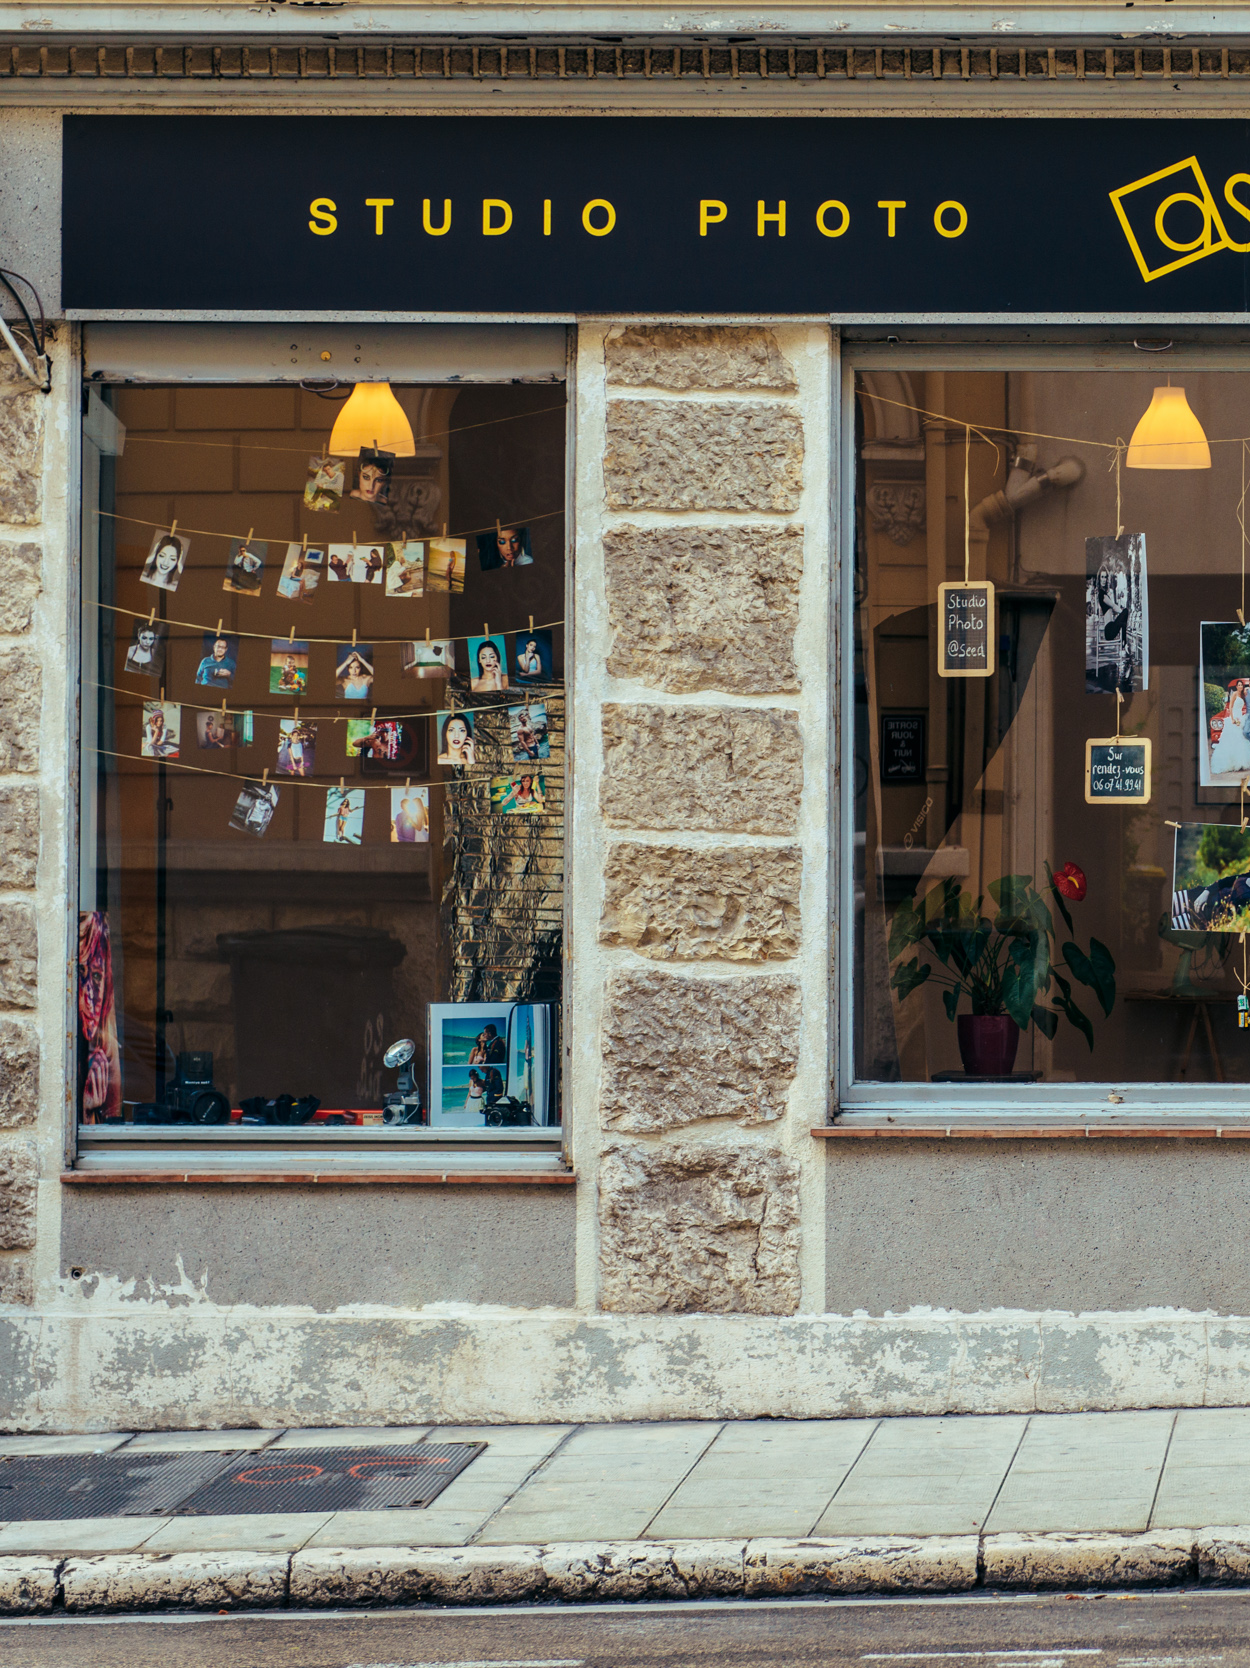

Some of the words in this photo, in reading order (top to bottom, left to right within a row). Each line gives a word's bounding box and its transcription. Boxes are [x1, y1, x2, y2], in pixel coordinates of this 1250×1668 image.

[308, 197, 617, 236] STUDIO
[699, 199, 968, 238] PHOTO
[947, 593, 986, 609] Studio
[948, 613, 984, 631] Photo
[1107, 746, 1123, 761] Sur
[1092, 763, 1145, 779] rendez-vous
[910, 797, 934, 833] VISICO
